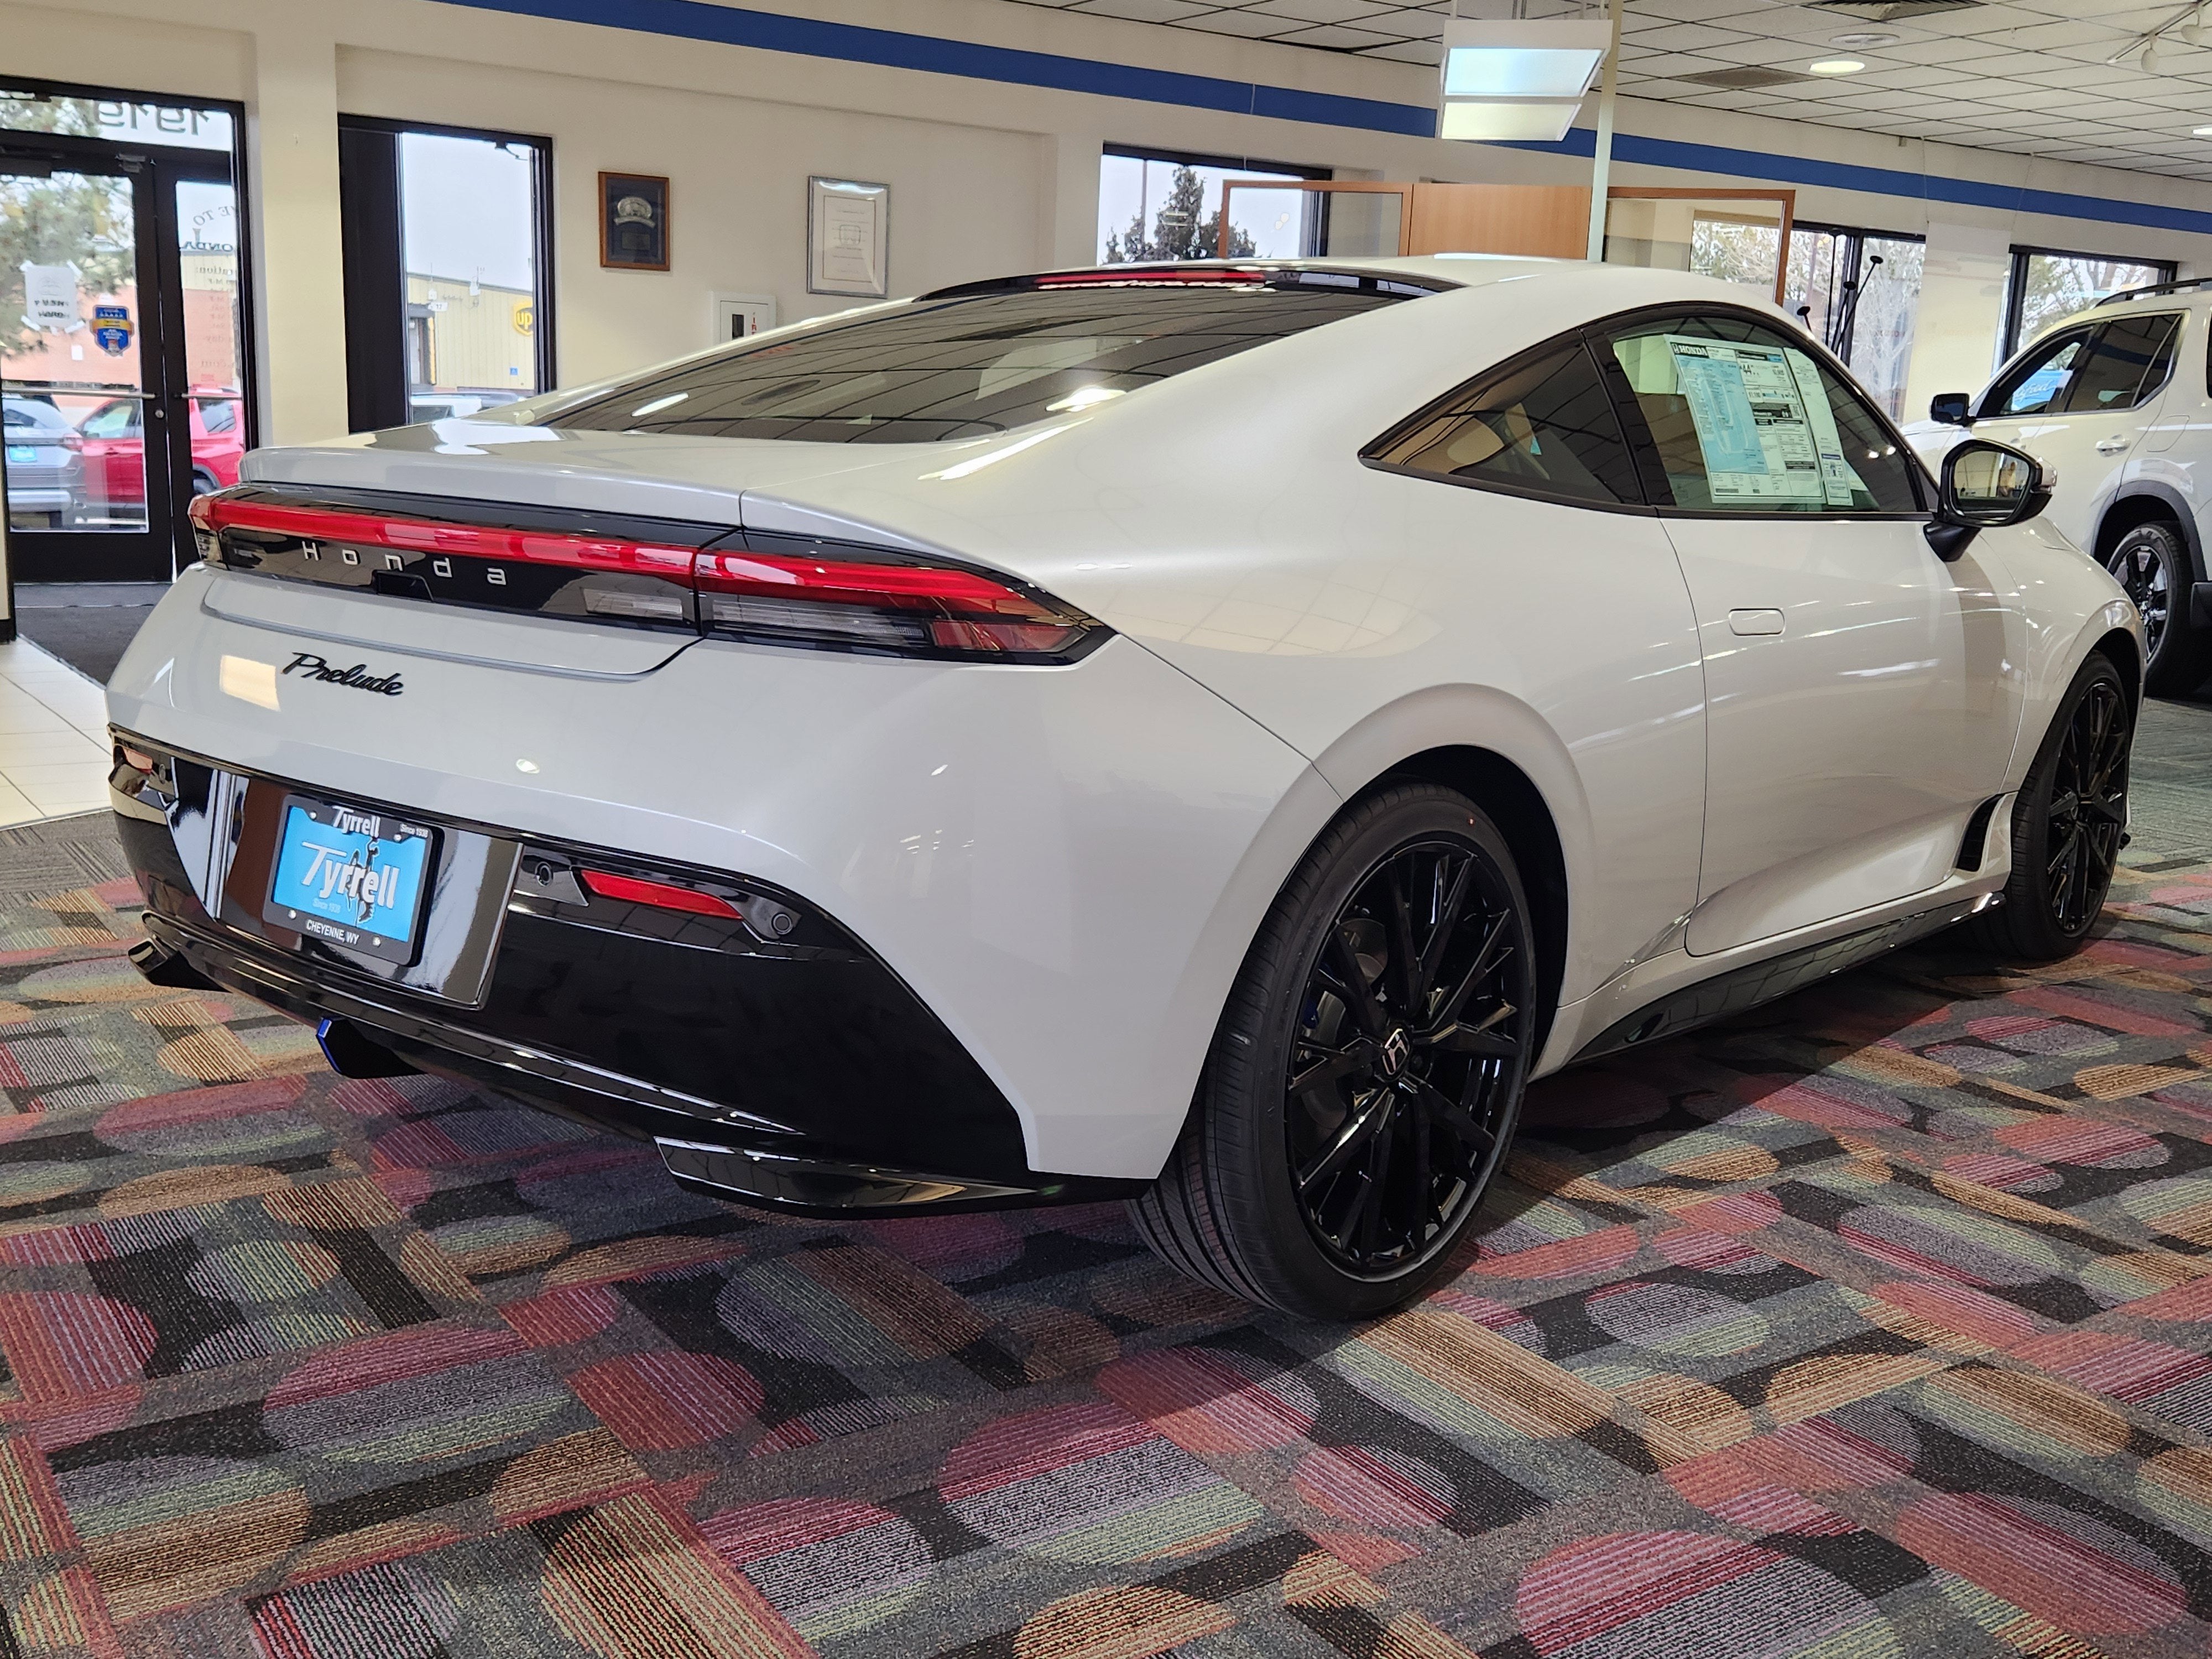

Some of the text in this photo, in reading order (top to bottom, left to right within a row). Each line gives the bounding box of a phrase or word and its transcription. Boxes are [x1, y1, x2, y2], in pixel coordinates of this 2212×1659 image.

[1678, 345, 1708, 356] HONDA
[301, 541, 507, 586] Honda
[280, 652, 404, 696] Prelude
[332, 805, 381, 838] Tyrrell
[301, 841, 400, 910] Tyrrell
[306, 919, 361, 945] CHEYENNE, WY
